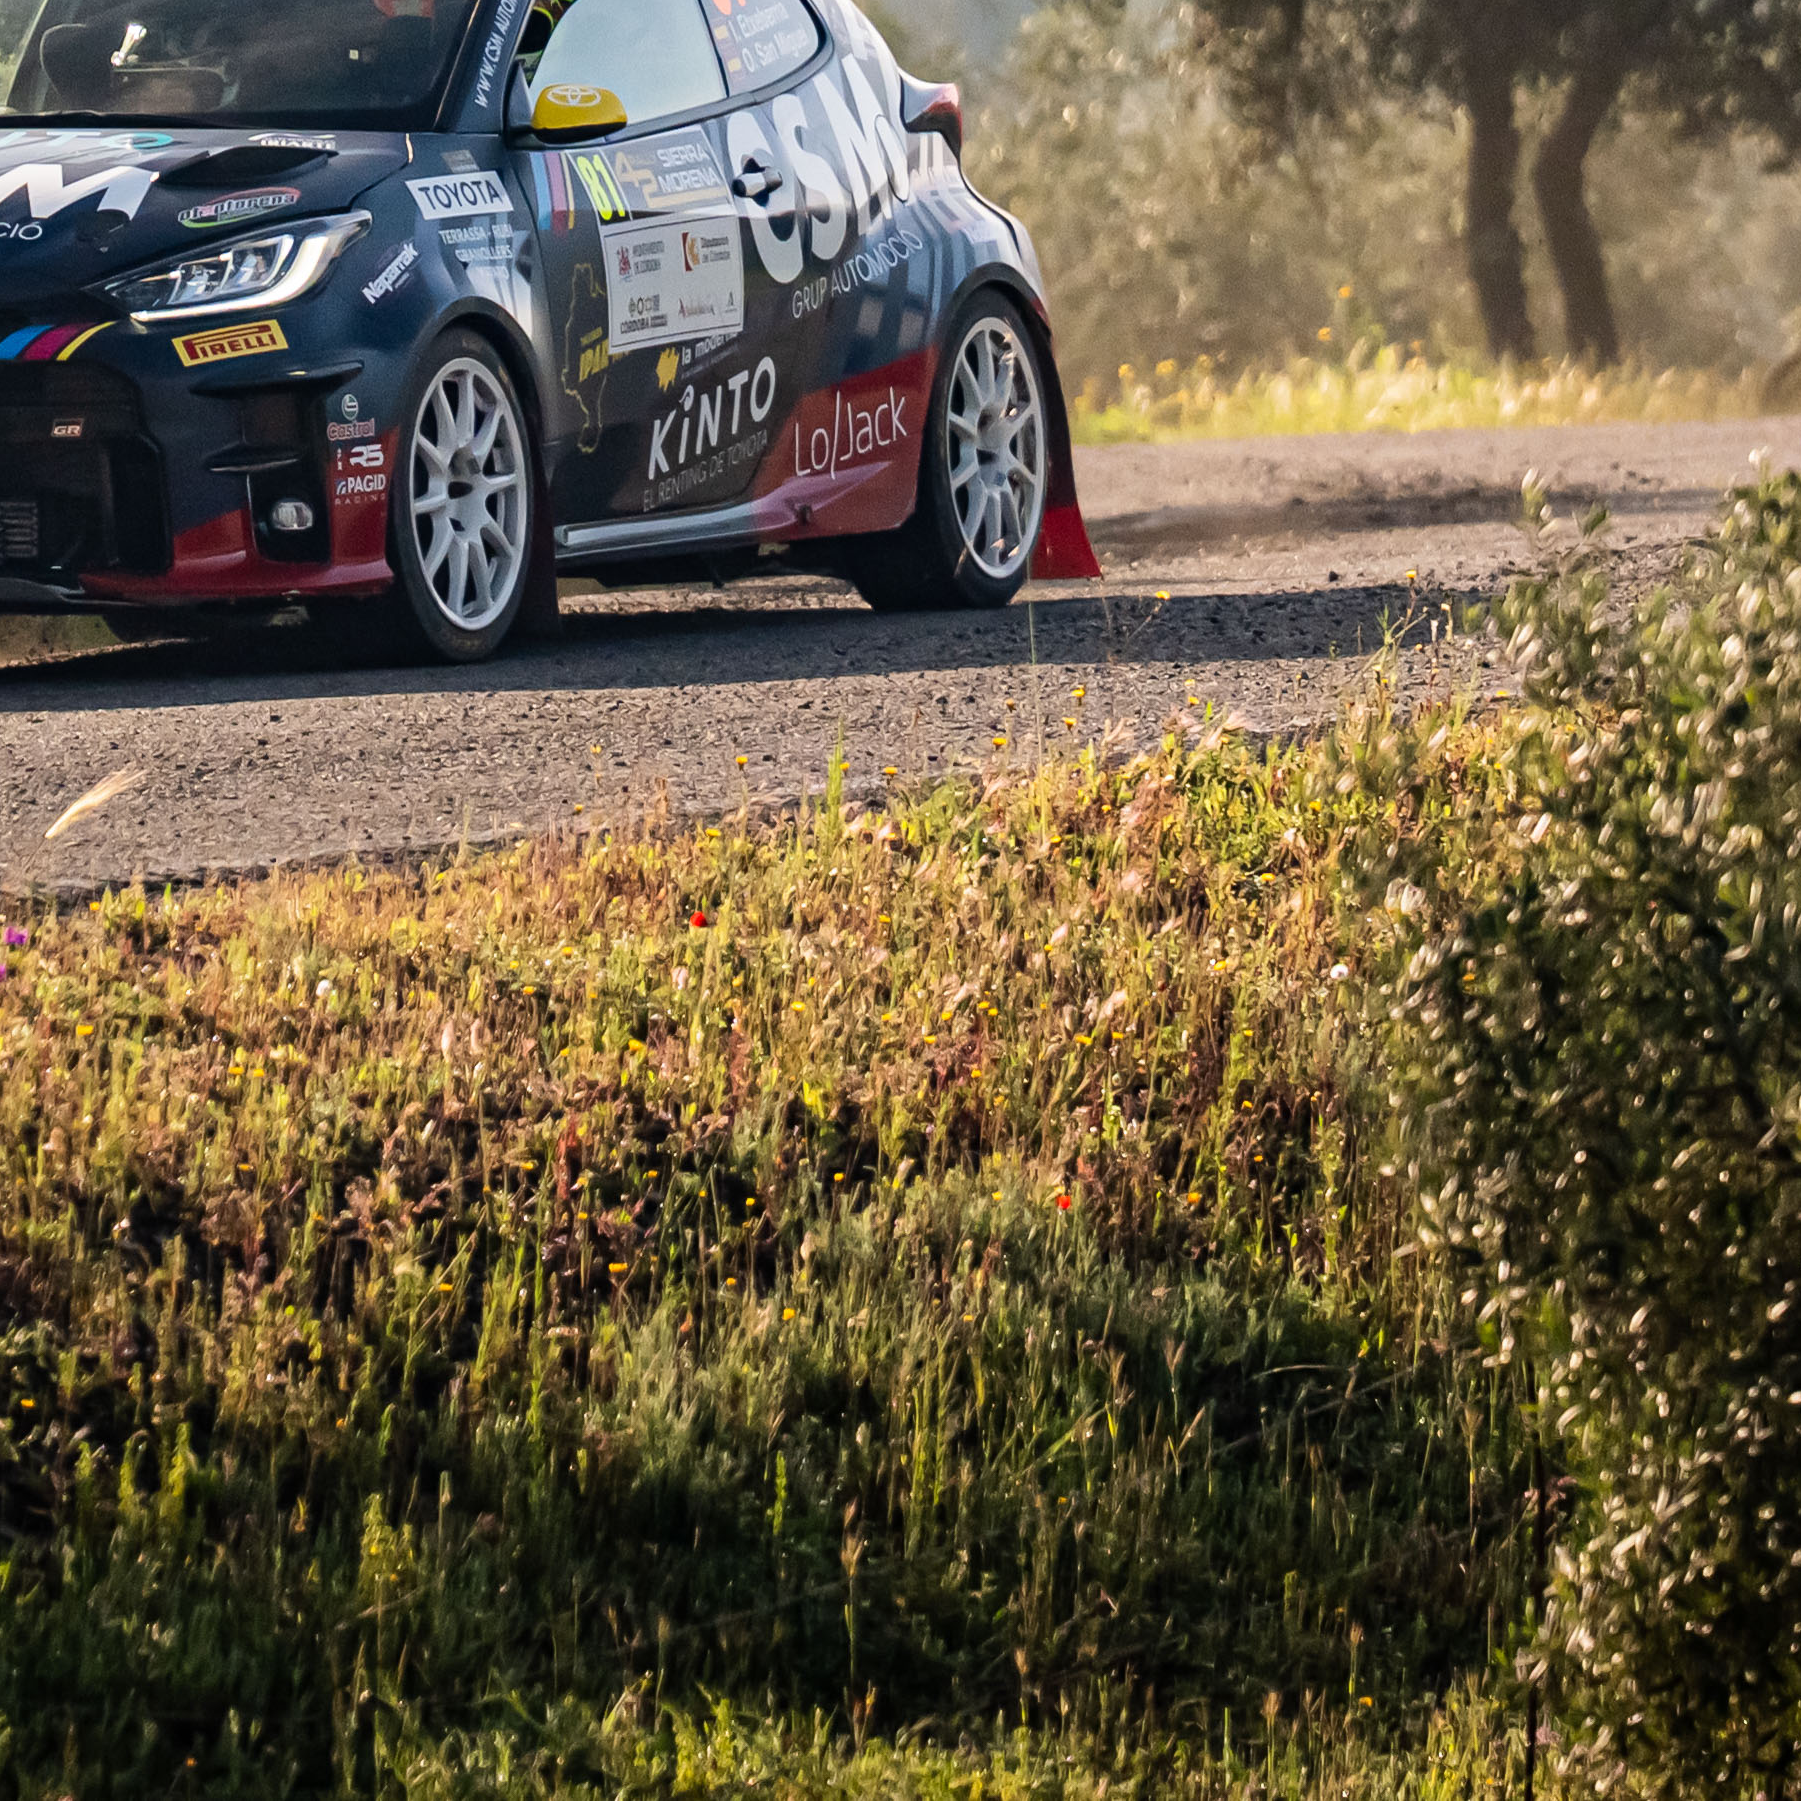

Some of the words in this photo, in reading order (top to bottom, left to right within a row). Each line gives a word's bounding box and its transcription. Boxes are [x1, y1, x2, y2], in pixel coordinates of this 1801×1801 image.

[656, 144, 710, 167] SIERRA
[727, 52, 909, 284] CSM
[577, 155, 625, 220] 81
[658, 167, 722, 194] MORENA
[418, 180, 503, 211] TOYOTA
[792, 277, 827, 318] GRUP
[182, 324, 278, 361] PIRELLI
[53, 424, 82, 436] GR
[327, 418, 375, 441] Castrol
[347, 474, 386, 493] PAGID
[643, 489, 657, 513] EL
[658, 463, 708, 504] RENTING
[709, 454, 725, 477] DE
[726, 429, 768, 469] TOYOTA
[335, 493, 386, 506] RACING
